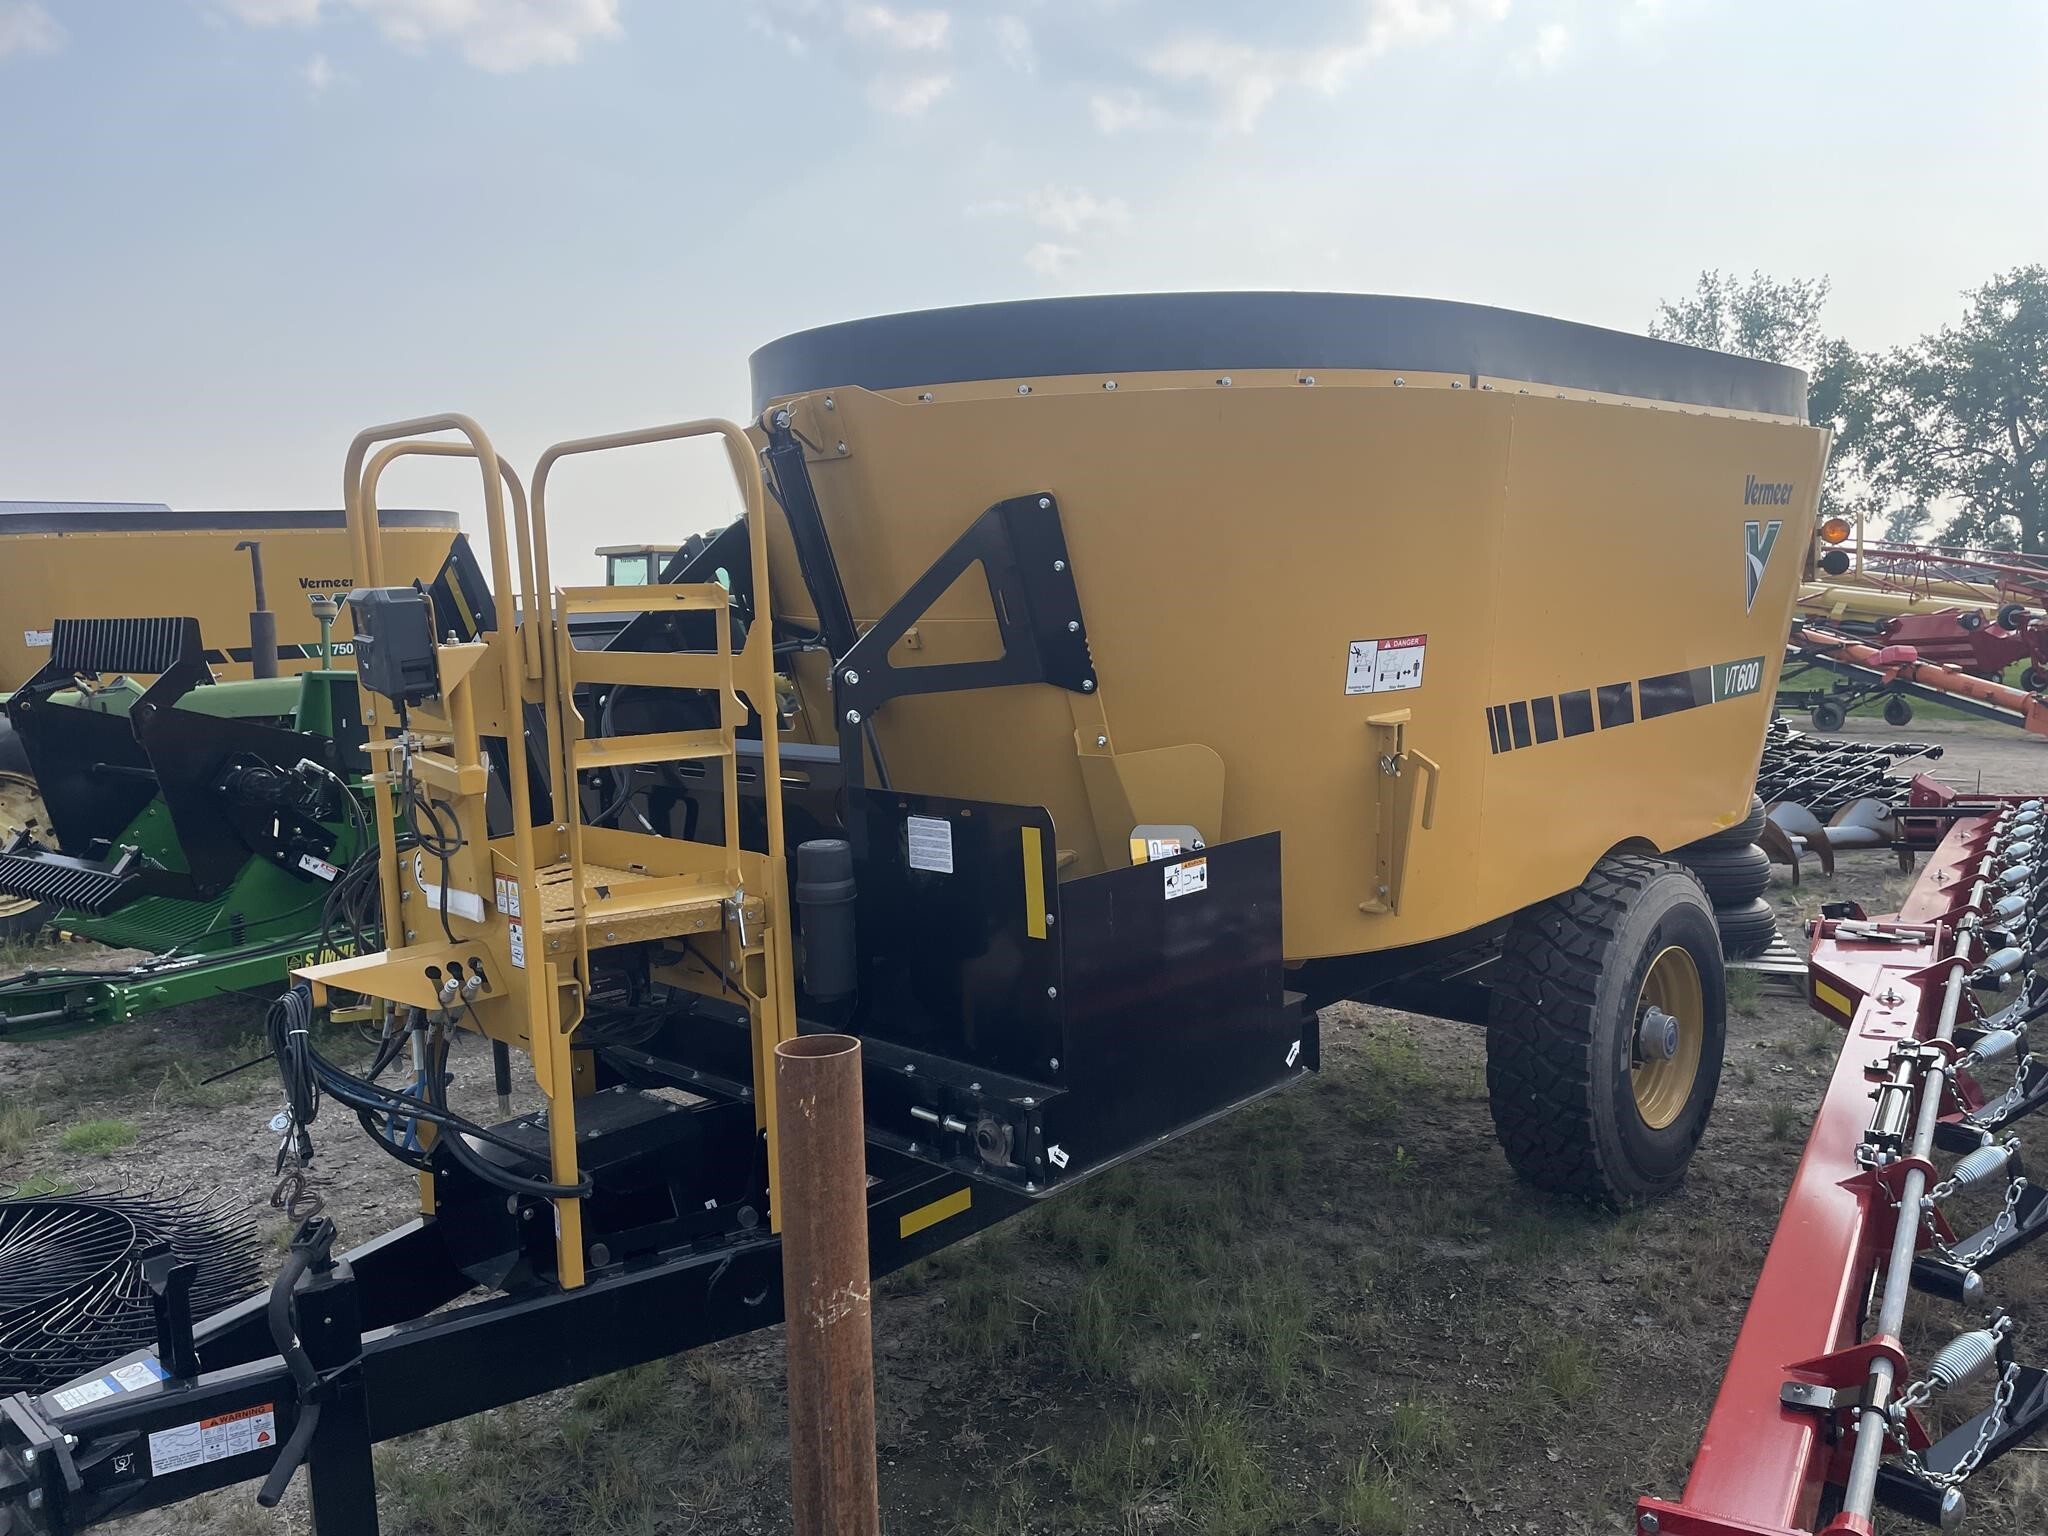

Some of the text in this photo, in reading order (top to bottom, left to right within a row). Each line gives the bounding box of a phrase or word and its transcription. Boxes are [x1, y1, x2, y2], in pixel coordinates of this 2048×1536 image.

[1744, 474, 1793, 505] Vermeer
[299, 578, 354, 589] Vermeer
[316, 643, 354, 656] V750
[1393, 638, 1419, 648] DANGER
[1724, 661, 1760, 696] VT600
[220, 1406, 266, 1423] WARNING
